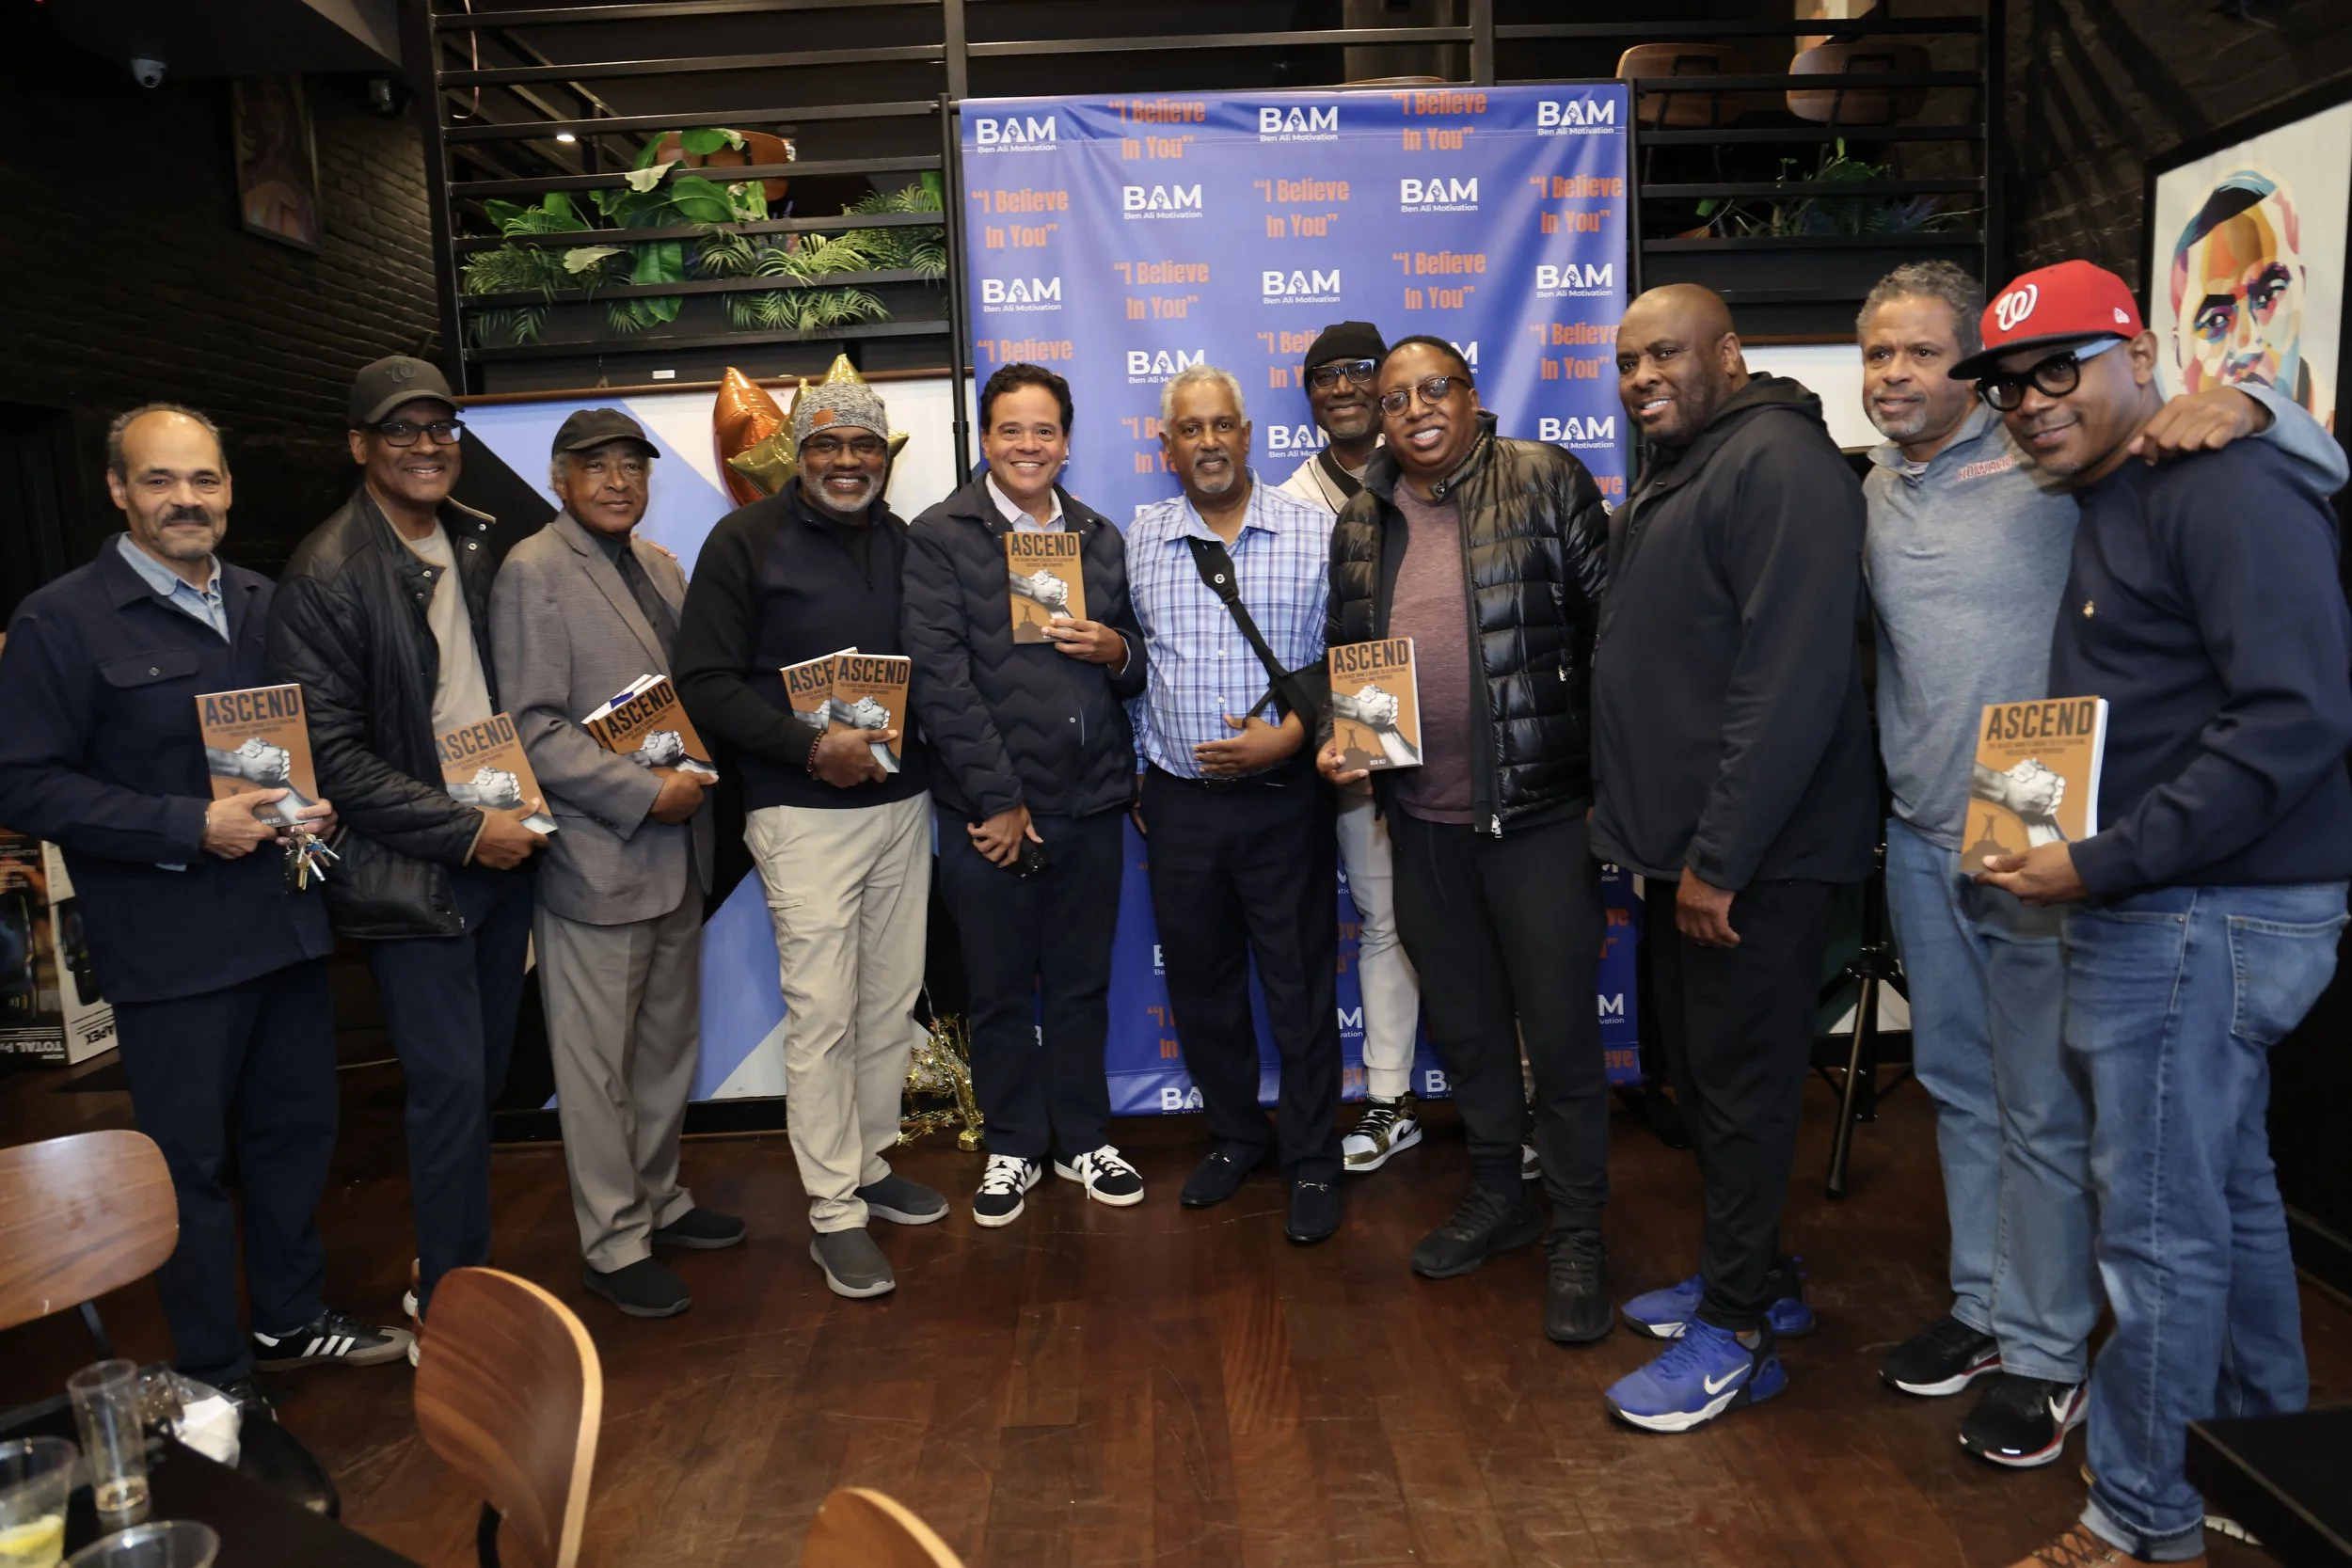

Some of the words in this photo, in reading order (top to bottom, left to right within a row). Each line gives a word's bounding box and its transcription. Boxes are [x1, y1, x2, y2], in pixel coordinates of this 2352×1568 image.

[1132, 97, 1205, 123] Believe
[1414, 91, 1487, 115] Believe
[1537, 100, 1614, 126] BAM
[976, 117, 1056, 144] BAM
[1259, 106, 1337, 133] BAM
[1555, 127, 1568, 135] Ali
[1568, 126, 1614, 135] Motivation
[977, 146, 996, 154] Ben
[1009, 144, 1057, 152] Motivation
[1120, 137, 1141, 160] In
[1291, 133, 1339, 141] Motivation
[1403, 128, 1422, 151] In
[1122, 184, 1201, 210] BAM
[1277, 178, 1350, 203] Believe
[1400, 178, 1477, 203] BAM
[1552, 174, 1624, 199] Believe
[994, 188, 1069, 214] Believe
[1419, 204, 1432, 213] Ali
[1432, 203, 1478, 212] Motivation
[1123, 212, 1142, 220] Ben
[1142, 211, 1155, 219] Ali
[1155, 210, 1203, 219] Motivation
[1265, 214, 1286, 238] In
[1541, 211, 1559, 234] In
[985, 226, 1006, 249] In
[1136, 260, 1210, 285] Believe
[1415, 250, 1486, 276] Believe
[1262, 270, 1340, 294] BAM
[1536, 263, 1613, 289] BAM
[982, 277, 1060, 303] BAM
[1263, 296, 1281, 305] Ben
[1281, 295, 1295, 304] Ali
[1295, 295, 1341, 304] Motivation
[1405, 287, 1423, 309] In
[1568, 289, 1613, 297] Motivation
[1001, 304, 1015, 312] Ali
[1014, 303, 1062, 312] Motivation
[1126, 296, 1147, 320] In
[999, 339, 1073, 363] Believe
[1270, 365, 1288, 388] In
[1541, 357, 1559, 380] In
[1537, 416, 1615, 441] BAM
[1135, 451, 1152, 473] In
[1288, 450, 1299, 458] Ali
[1010, 534, 1077, 557] ASCEND
[1333, 640, 1409, 673] ASCEND
[788, 660, 833, 694] ASCE
[837, 657, 909, 685] ASCEND
[205, 688, 300, 726] ASCEND
[606, 682, 675, 739] ASCEND
[1986, 700, 2095, 741] ASCEND
[436, 716, 515, 765] ASCEND
[1600, 1017, 1625, 1025] vation
[16, 1040, 64, 1053] TOTAL
[1159, 1038, 1178, 1059] In
[1160, 1086, 1204, 1110] BA
